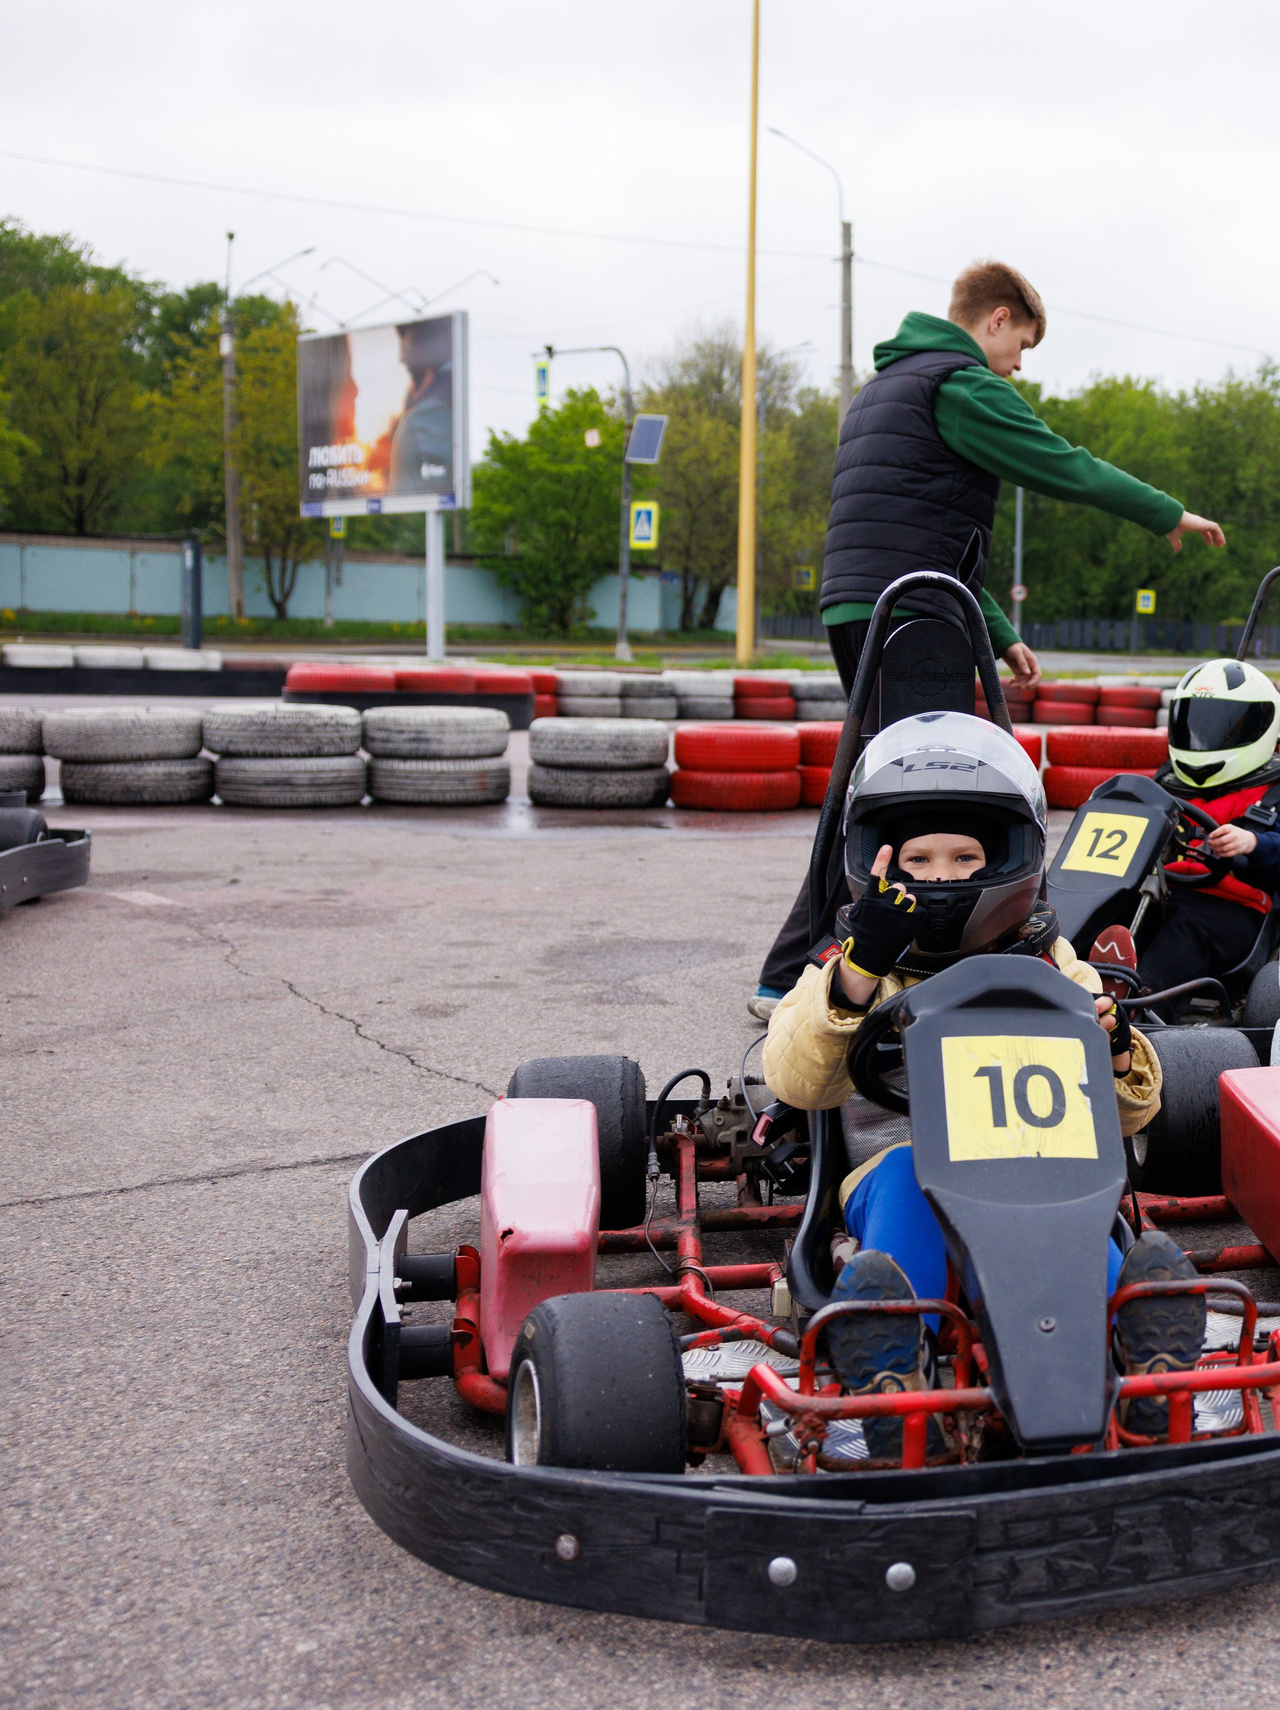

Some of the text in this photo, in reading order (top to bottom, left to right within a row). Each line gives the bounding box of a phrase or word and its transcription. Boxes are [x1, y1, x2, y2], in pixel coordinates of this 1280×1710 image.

[308, 443, 364, 468] ЛЮБИТЬ
[903, 761, 977, 773] LS2
[1086, 828, 1128, 860] 12
[973, 1064, 1066, 1129] 10
